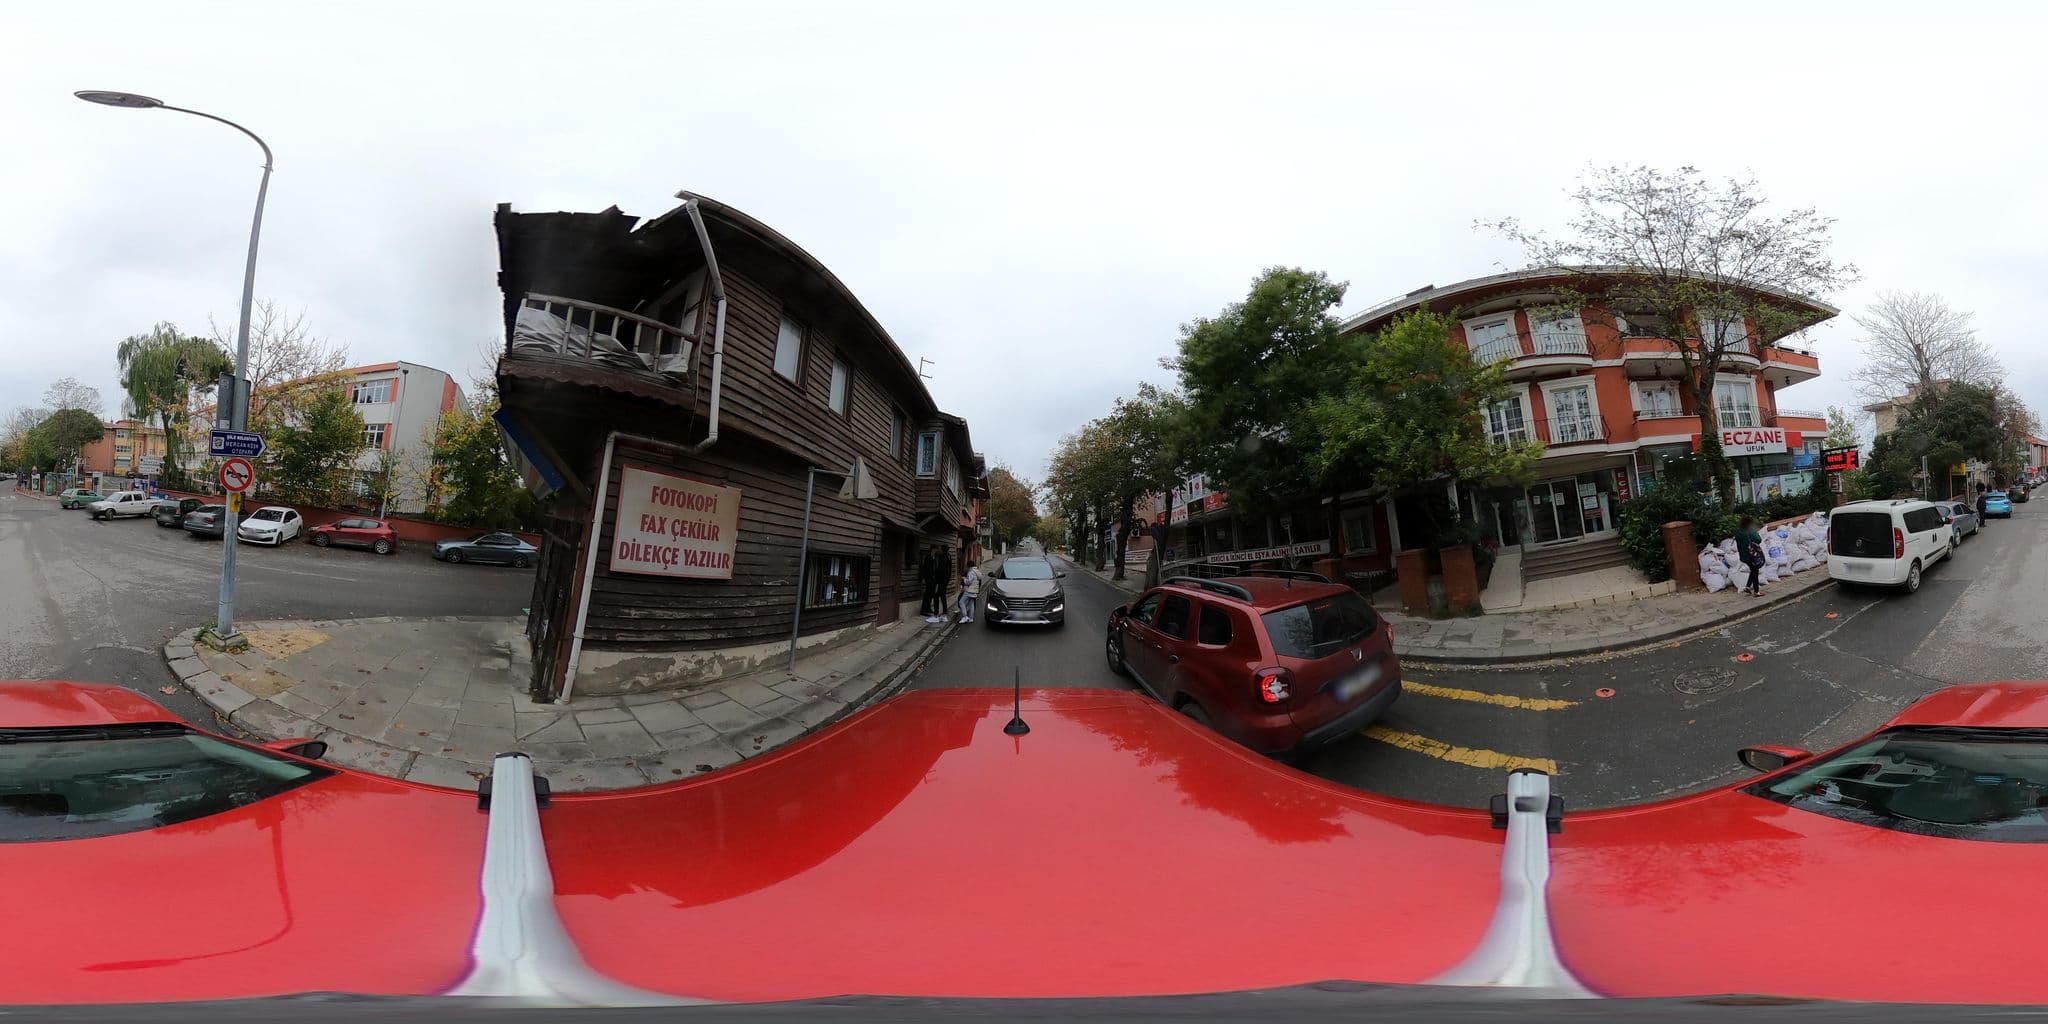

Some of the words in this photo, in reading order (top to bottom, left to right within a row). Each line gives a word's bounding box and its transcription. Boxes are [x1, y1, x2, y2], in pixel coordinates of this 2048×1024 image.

[1722, 430, 1783, 446] ECZANE
[651, 485, 718, 514] FOTOKOPİ
[640, 513, 667, 535] FAX
[670, 518, 720, 542] ÇEKİLİR
[619, 538, 679, 570] DİLEKÇE
[684, 549, 730, 569] YAZILIR
[1255, 549, 1270, 560] EŞYA
[1294, 543, 1321, 555] SATILIR
